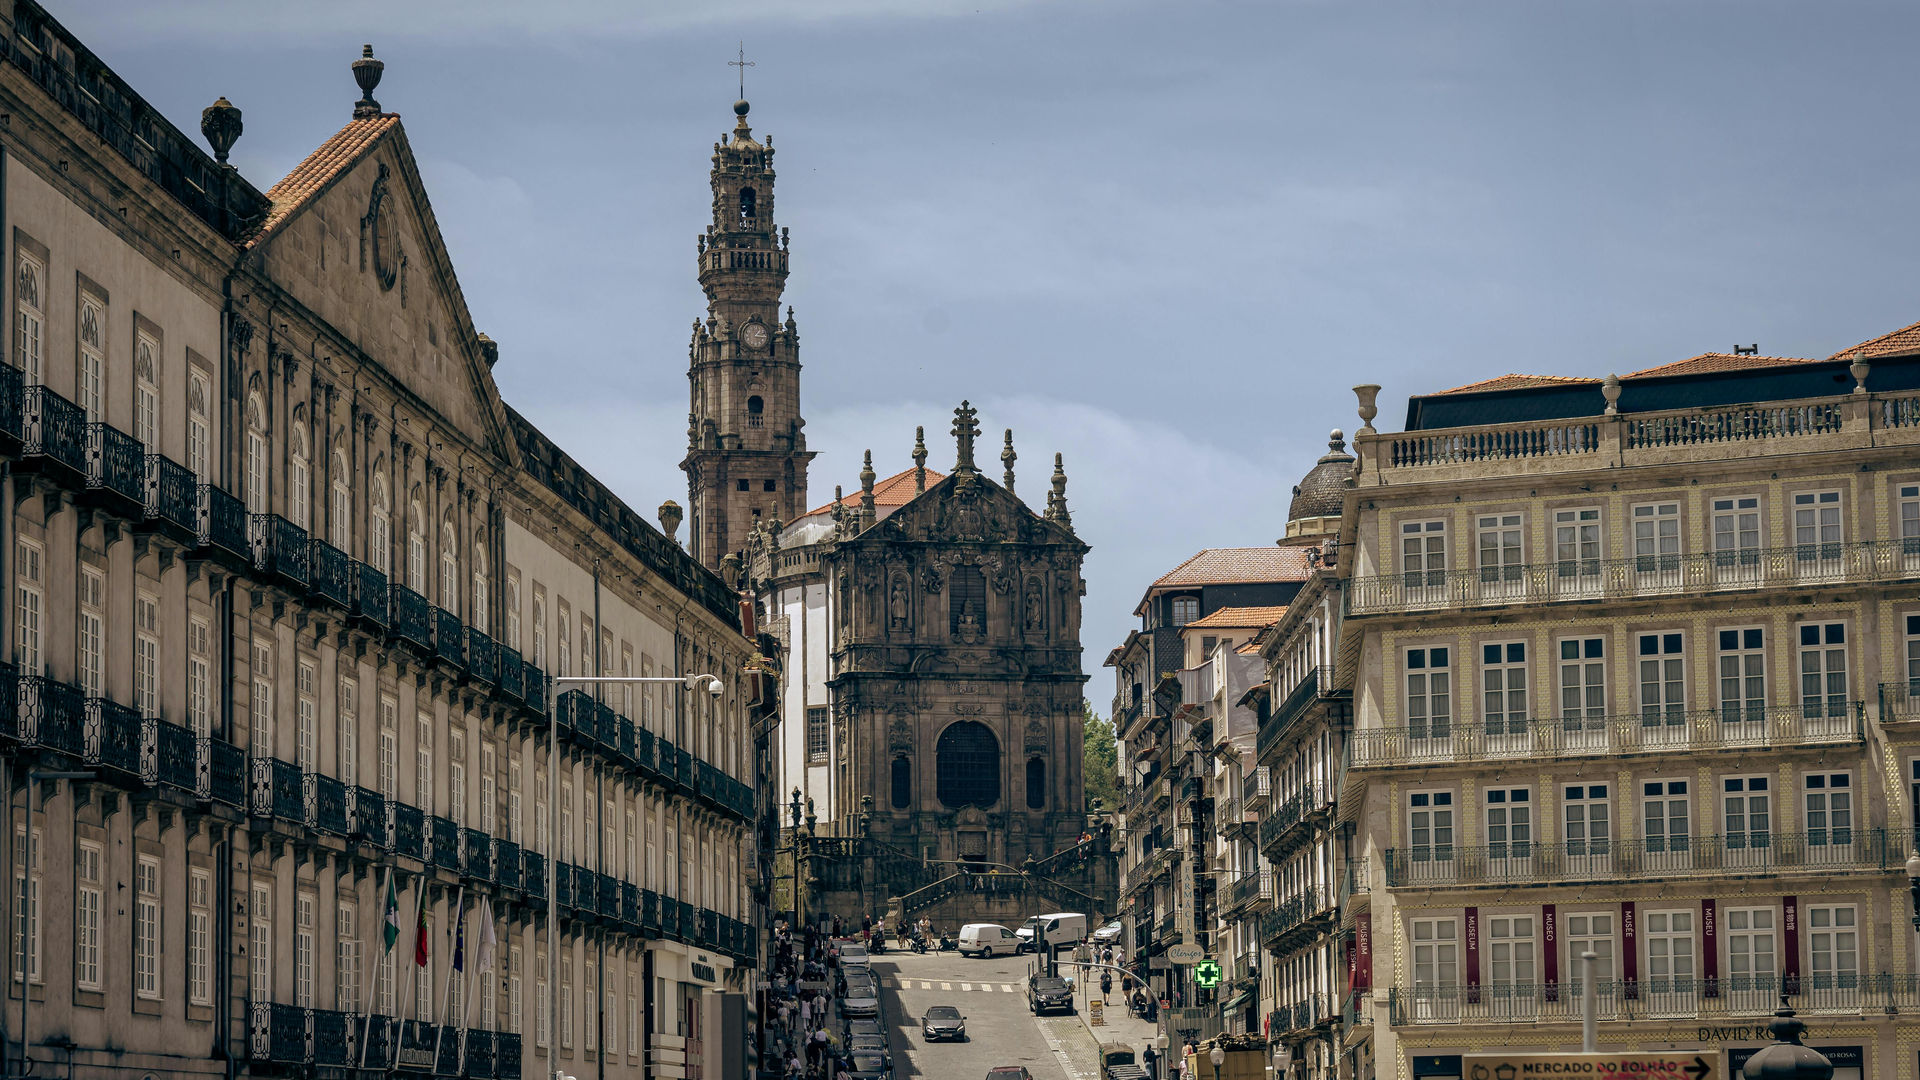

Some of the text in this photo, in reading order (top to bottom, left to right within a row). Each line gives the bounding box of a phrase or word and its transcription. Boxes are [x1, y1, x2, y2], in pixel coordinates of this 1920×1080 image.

[1184, 866, 1192, 935] FARMÁCIA
[1468, 916, 1476, 950] MUSEUM
[1545, 913, 1553, 941] MUSEO
[1624, 910, 1634, 938] MUSÉE
[1705, 908, 1713, 936] MUSEU
[1360, 921, 1368, 955] MUSEUM
[1698, 1027, 1750, 1041] DAVID
[1523, 1063, 1593, 1073] MERCADO
[1597, 1062, 1617, 1073] DO
